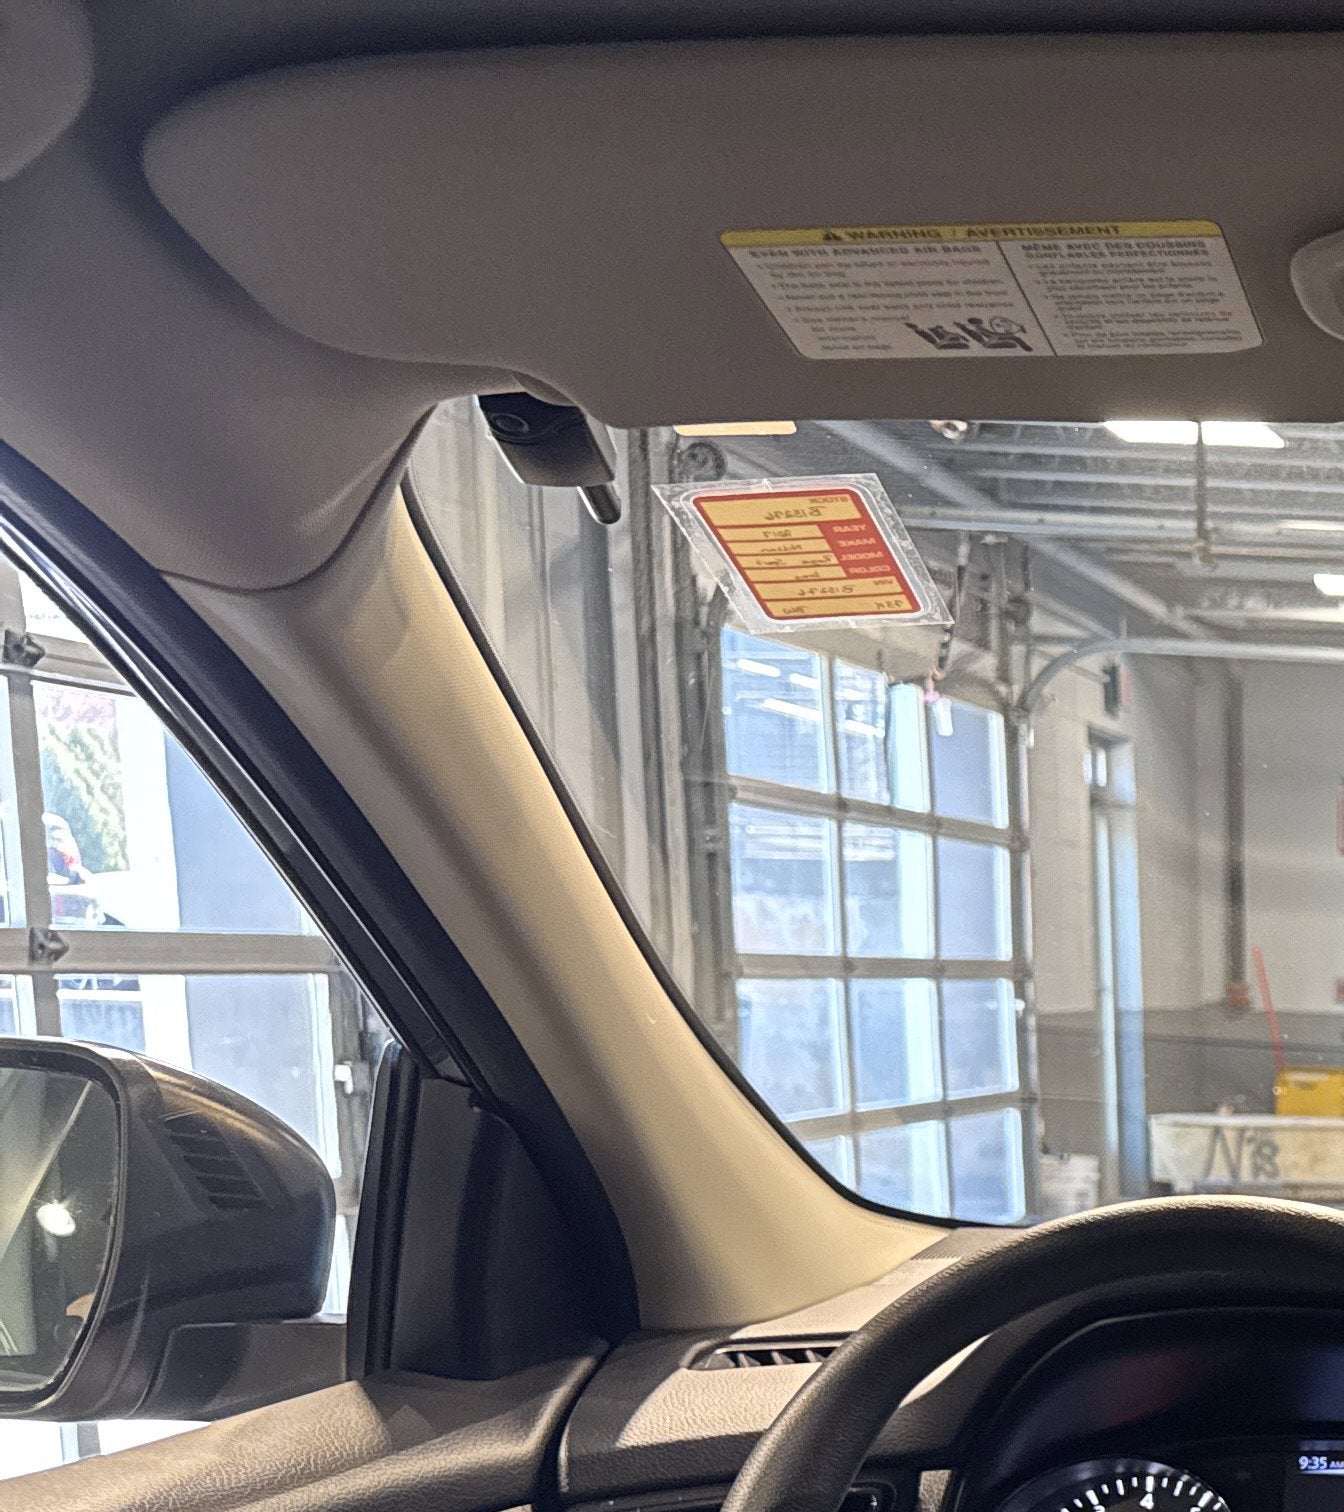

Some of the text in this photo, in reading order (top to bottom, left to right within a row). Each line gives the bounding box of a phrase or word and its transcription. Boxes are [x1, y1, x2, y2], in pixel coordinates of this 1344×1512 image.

[848, 229, 941, 240] WARNING
[967, 225, 1120, 238] AVERTISSEMENT
[1298, 1456, 1344, 1470] 9:35 AM
[1139, 1493, 1154, 1509] 4
